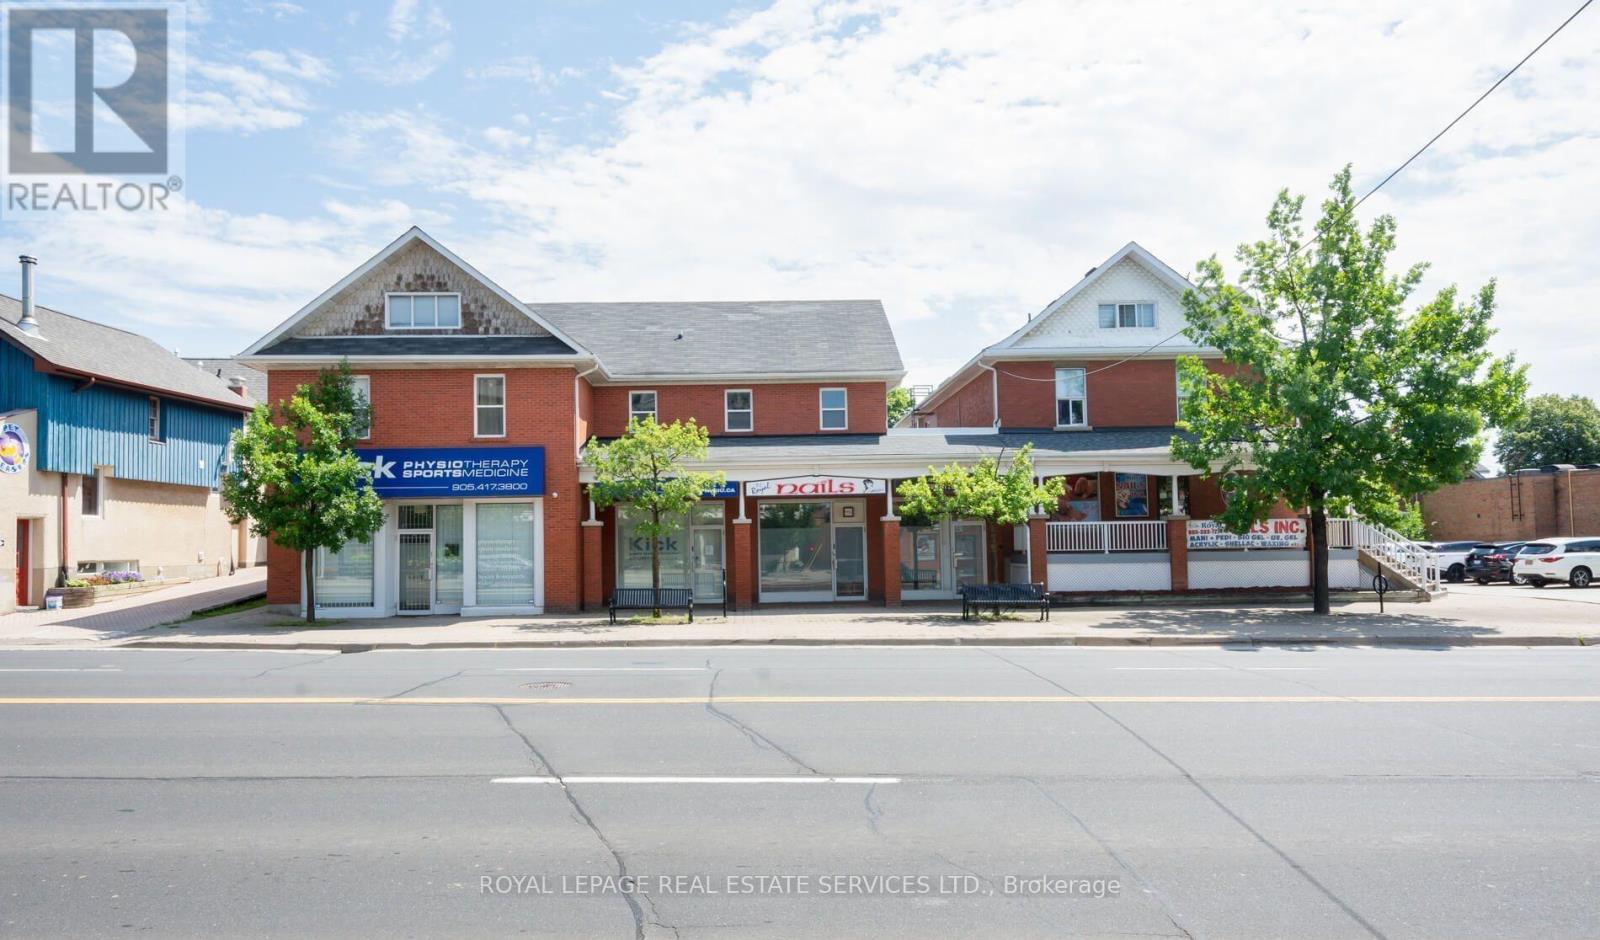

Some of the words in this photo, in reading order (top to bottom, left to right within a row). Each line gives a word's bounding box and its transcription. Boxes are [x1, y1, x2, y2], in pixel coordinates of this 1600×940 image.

[403, 459, 529, 470] PHYSIOTHERAPY
[402, 468, 529, 479] SPORTSMEDICINE
[451, 482, 528, 492] 905.417.3800
[776, 479, 855, 494] nails
[1274, 520, 1305, 534] INC.
